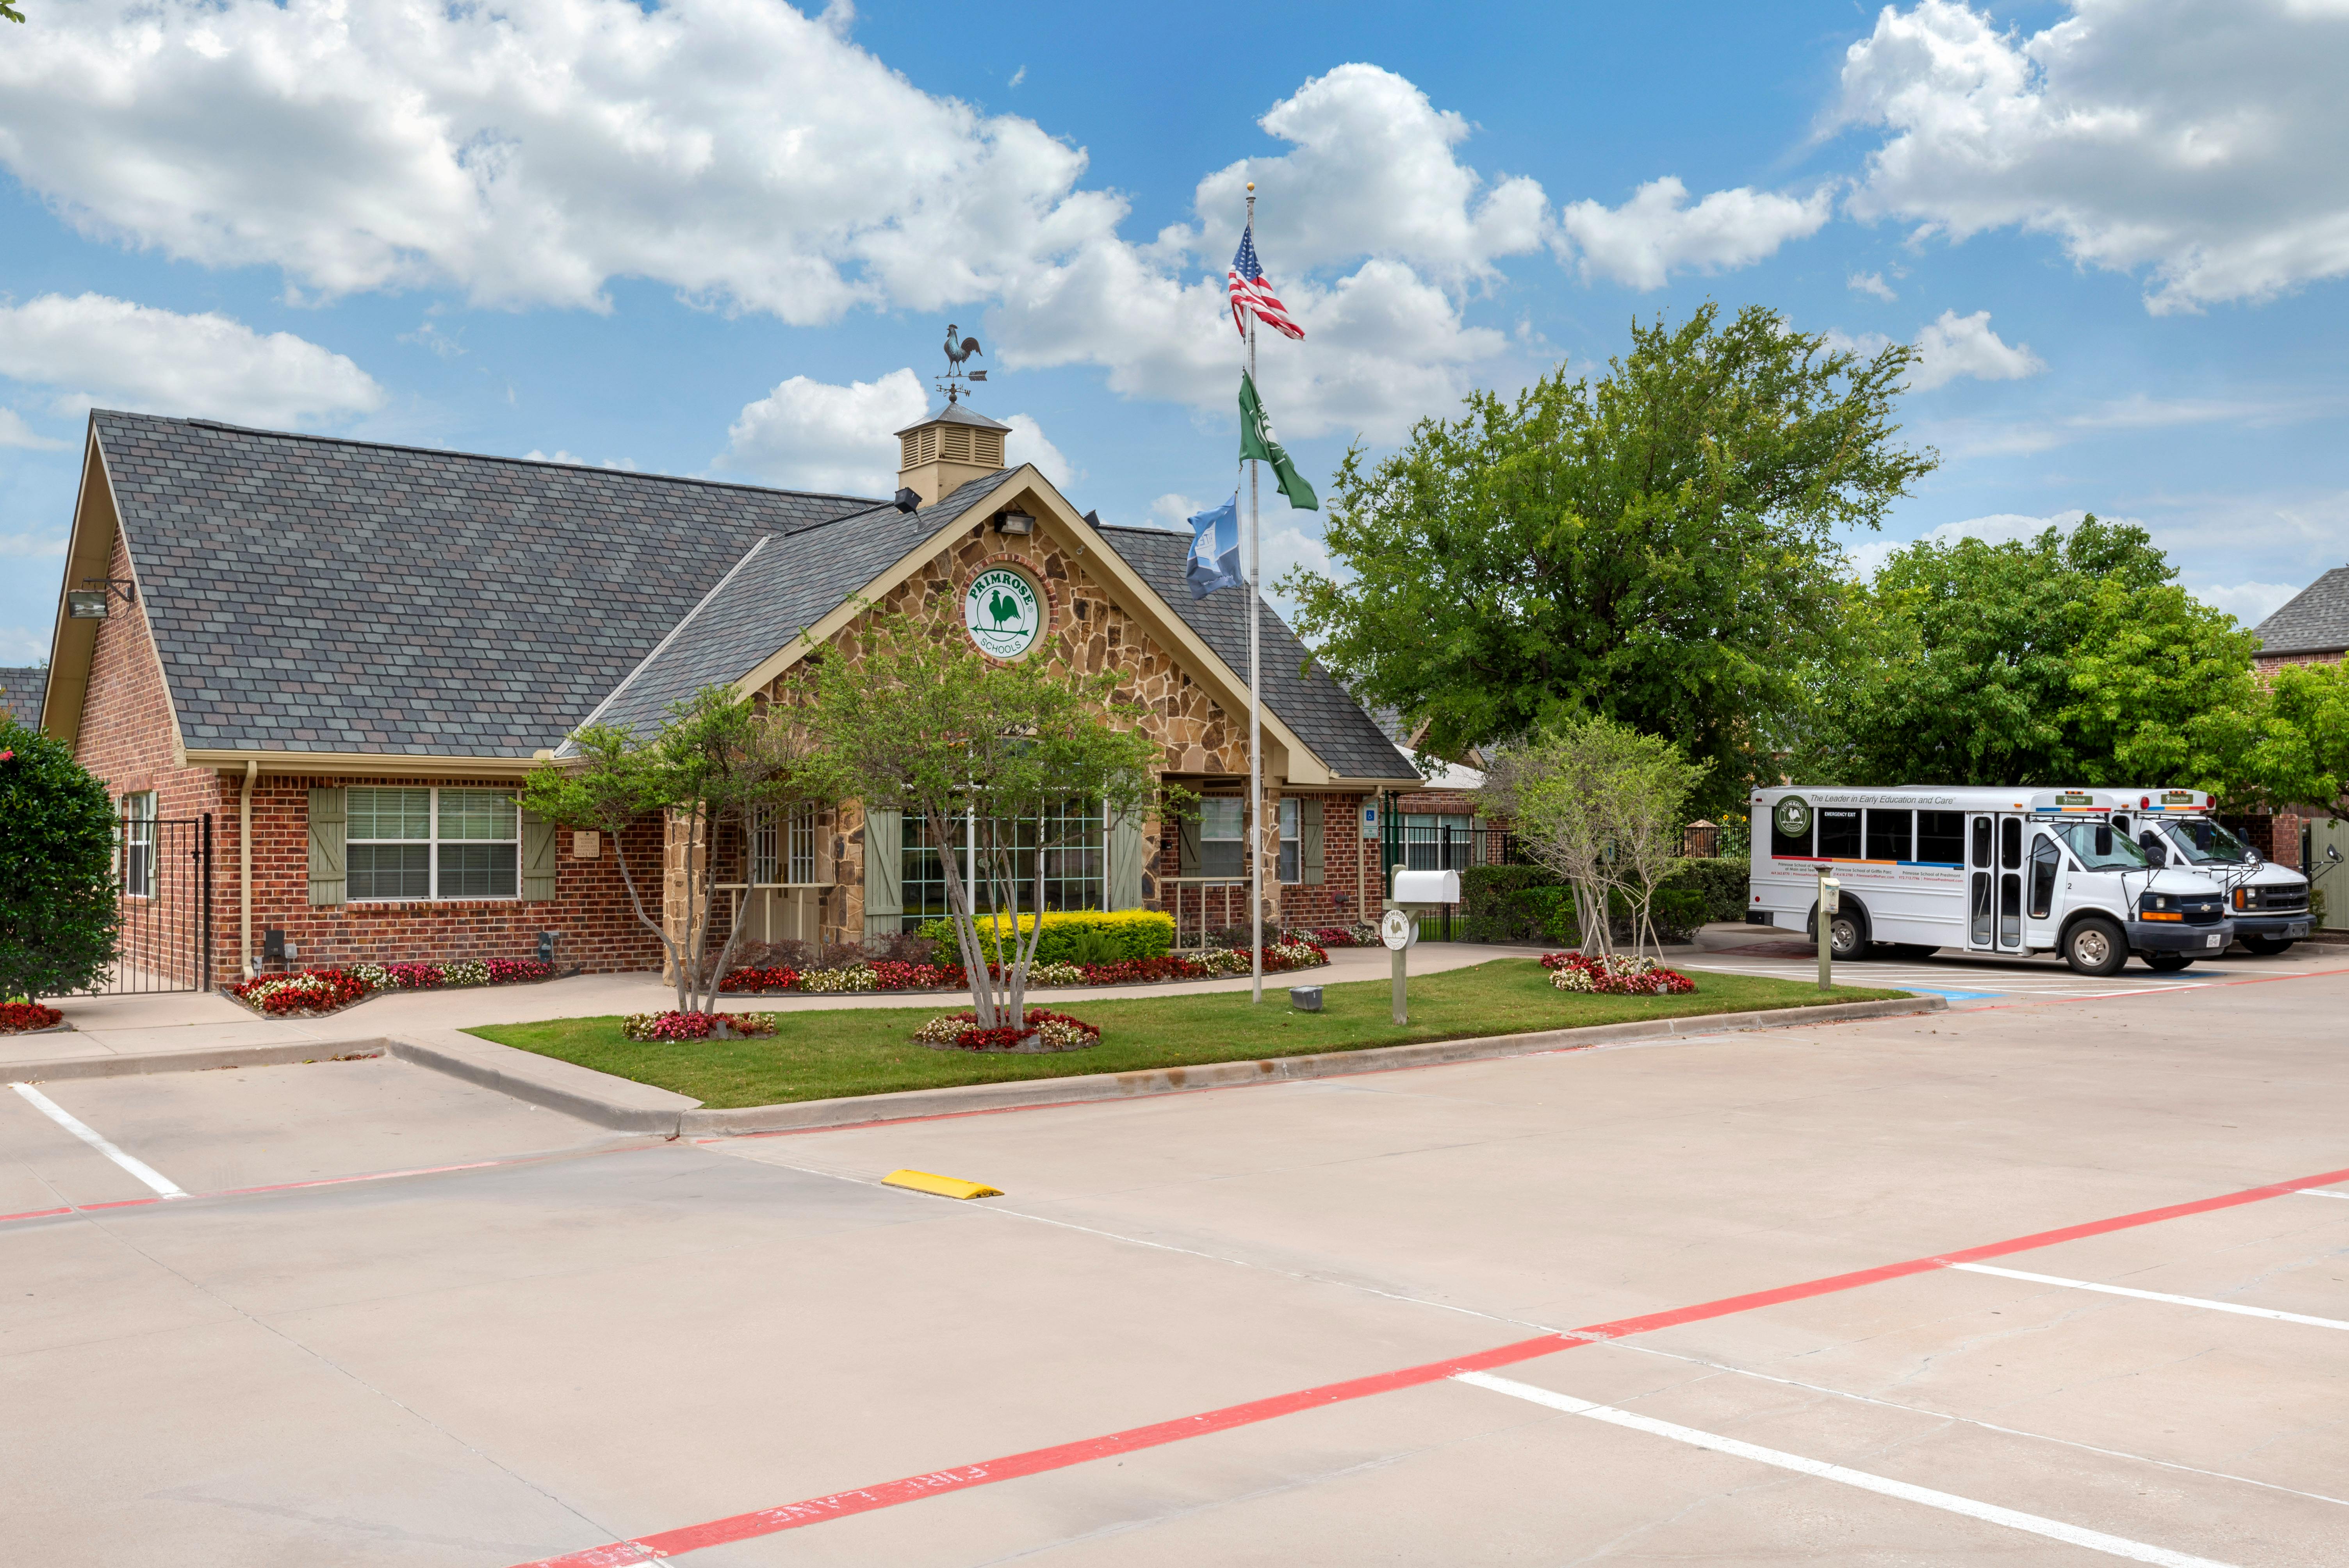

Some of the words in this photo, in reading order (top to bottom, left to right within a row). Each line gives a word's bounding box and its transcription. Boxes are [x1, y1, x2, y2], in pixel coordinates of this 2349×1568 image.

[969, 573, 1034, 606] PRIMROSE
[980, 638, 1021, 654] SCHOOLS
[1859, 795, 1878, 805] Early
[1782, 802, 1805, 813] PRIMROSE
[1383, 911, 1408, 925] PRIMROSE
